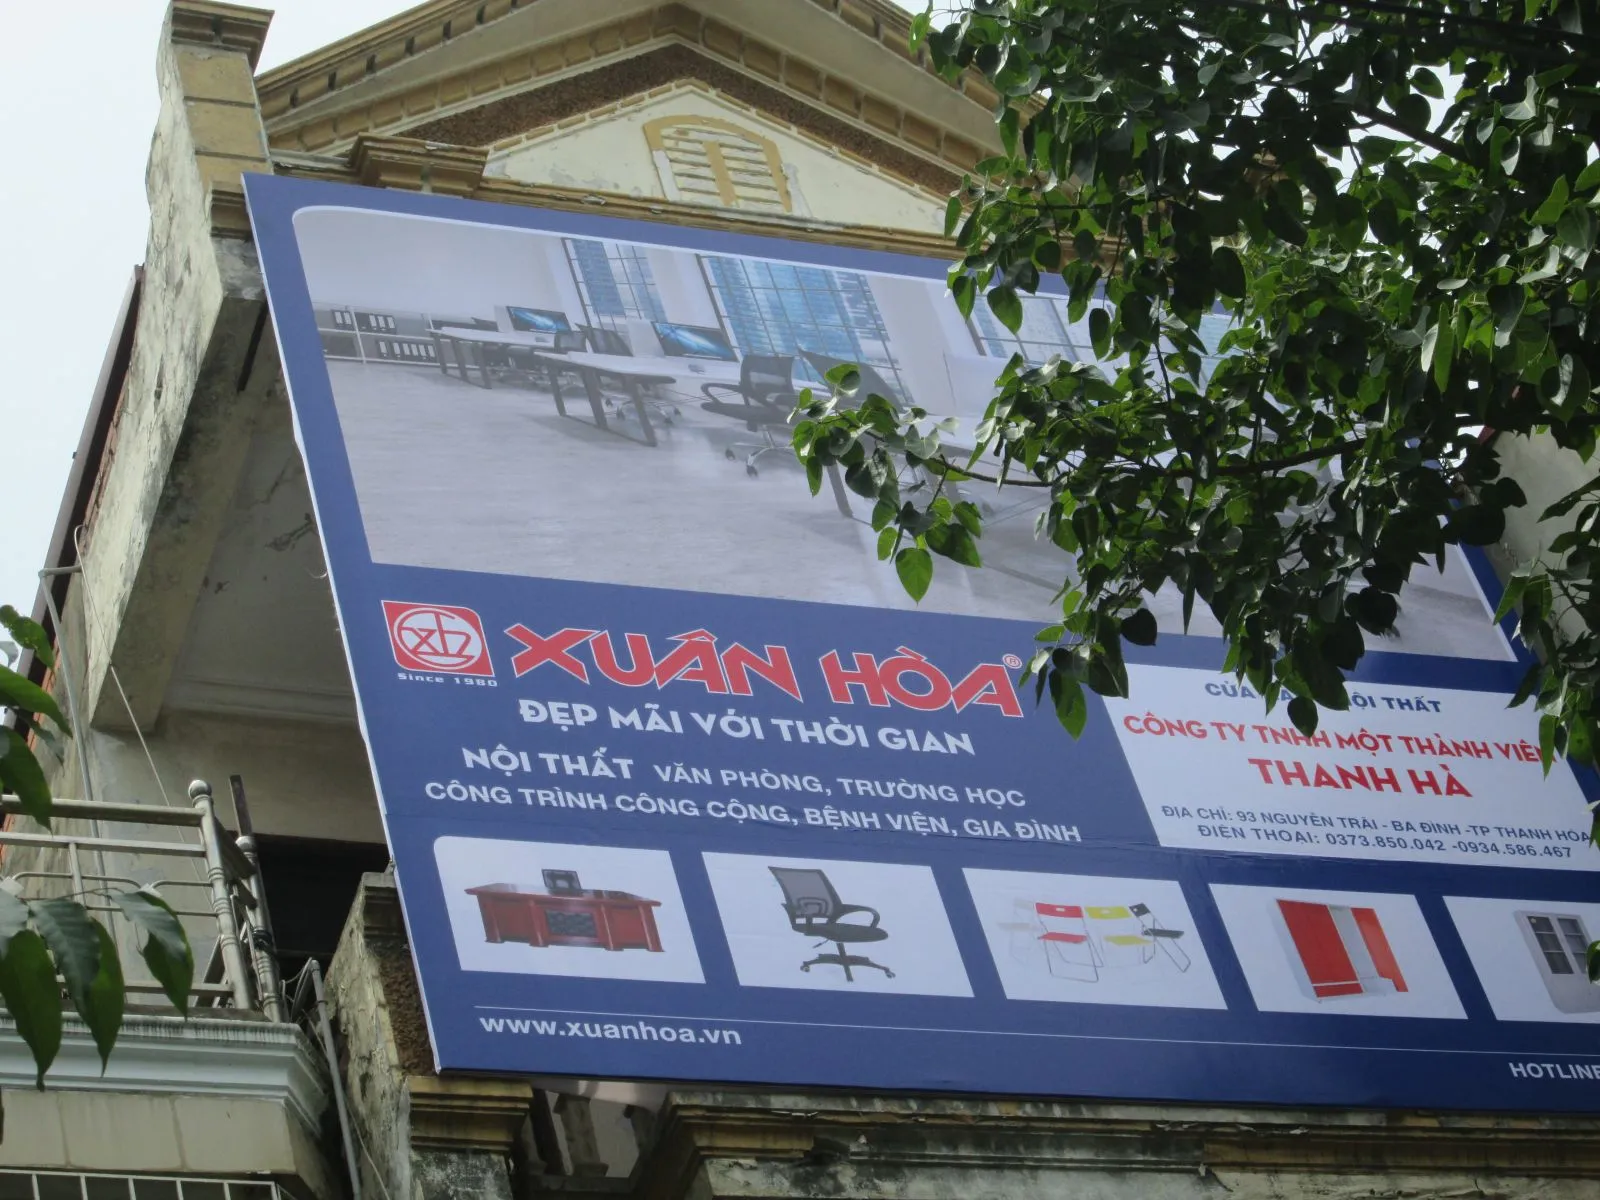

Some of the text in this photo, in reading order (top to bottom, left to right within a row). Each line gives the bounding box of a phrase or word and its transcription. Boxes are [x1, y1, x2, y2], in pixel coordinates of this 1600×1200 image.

[397, 672, 498, 687] Since 1980
[504, 623, 803, 703] XUÂN
[819, 645, 1023, 718] HÒA
[1381, 696, 1441, 713] THẤT
[519, 699, 976, 756] ĐẸP MÃI VỚI THỜI GIAN
[1123, 711, 1208, 740] CÔNG
[1210, 721, 1245, 742] TY
[1252, 725, 1332, 748] TNHH
[1334, 727, 1393, 757] MỘT
[1397, 732, 1493, 760] THÀNH
[462, 744, 1026, 810] NỘI THẤT VĂN PHÒNG, TRƯỜNG HỌC
[1248, 758, 1473, 798] THANH HÀ
[425, 780, 1082, 842] CÔNG TRÌNH CÔNG CỘNG, BỆNH VIỆN, GIA ĐÌNH
[1162, 805, 1193, 819] ĐỊA
[1236, 811, 1257, 823] 93
[1337, 816, 1378, 830] TRÃI
[1391, 820, 1417, 832] BA
[1494, 826, 1552, 840] THANH
[1326, 833, 1447, 851] 0373.850.042
[479, 1017, 742, 1045] www.xuanhoa.vn
